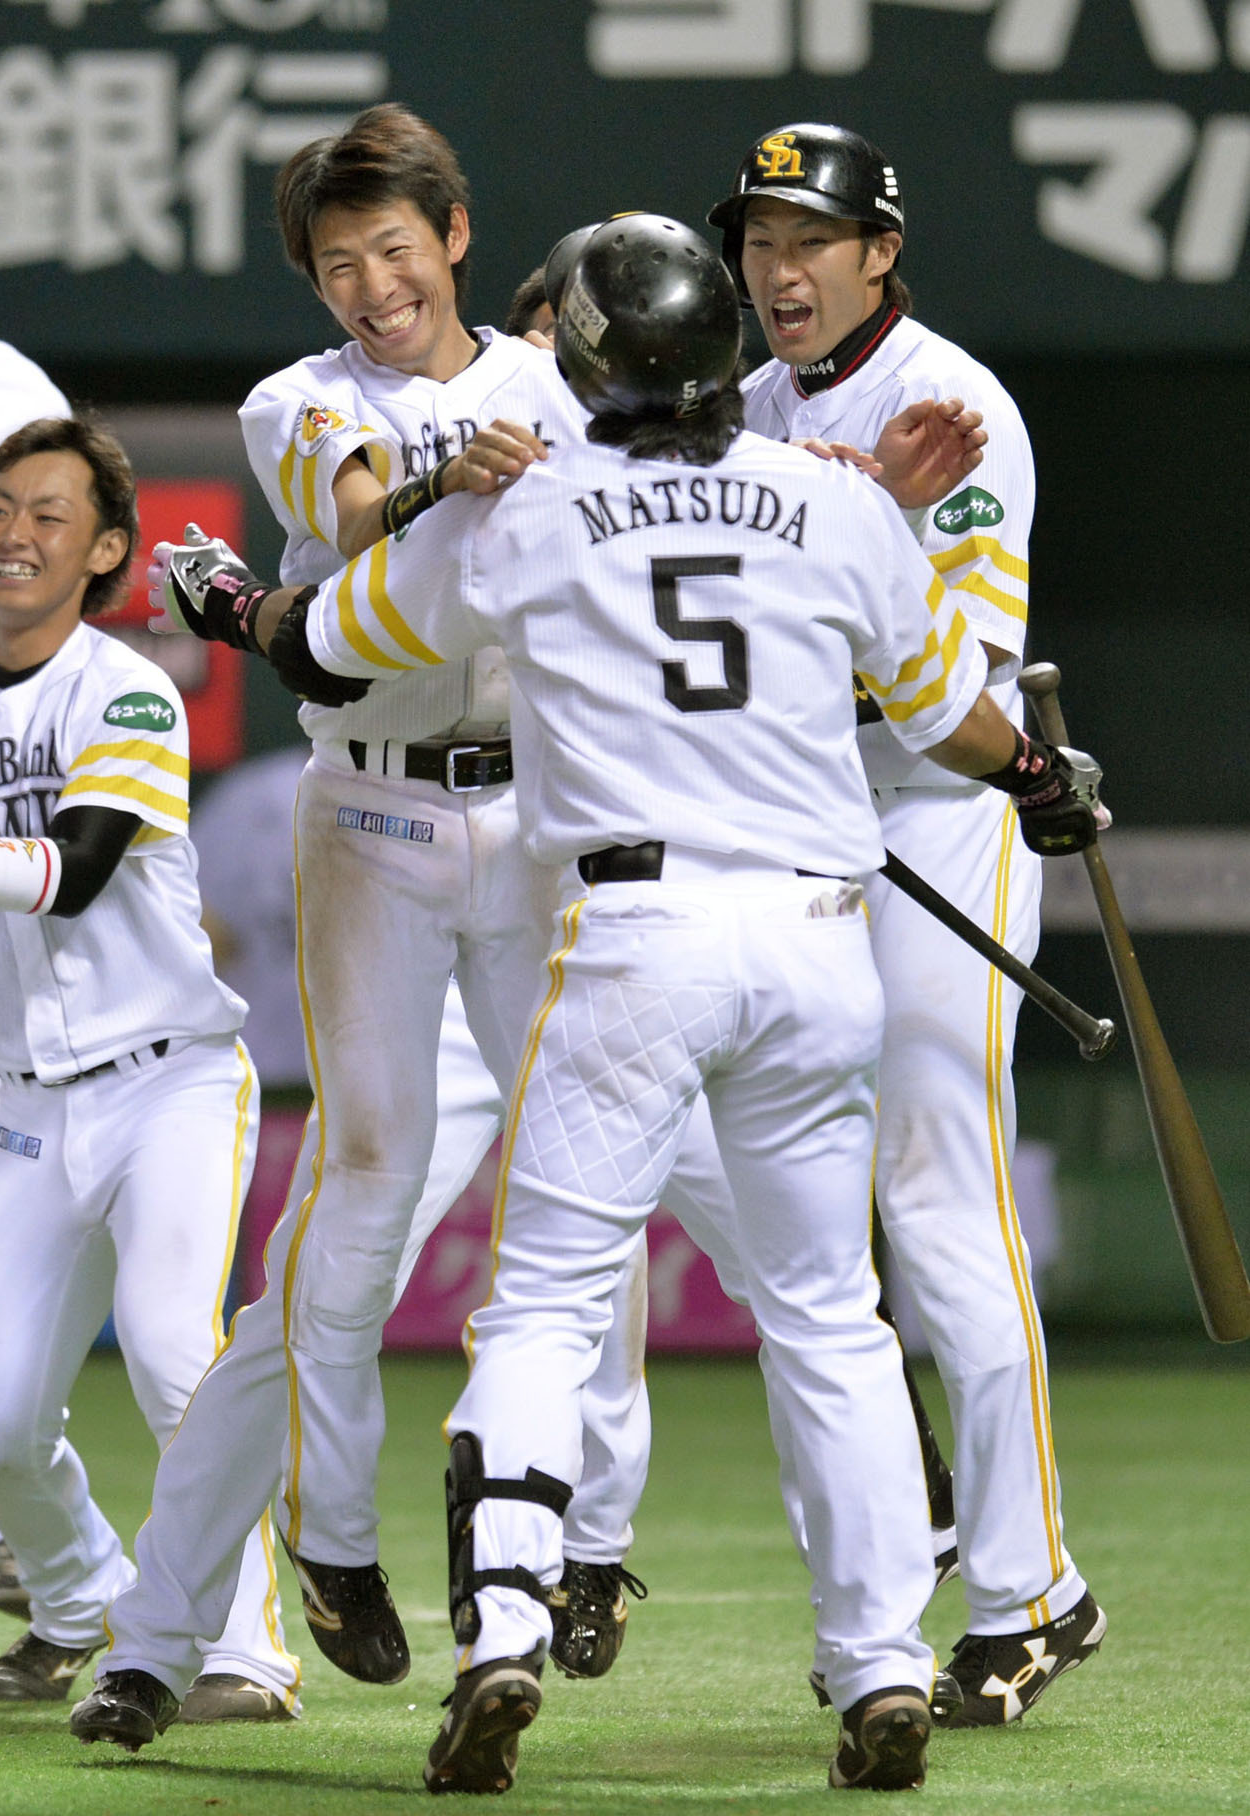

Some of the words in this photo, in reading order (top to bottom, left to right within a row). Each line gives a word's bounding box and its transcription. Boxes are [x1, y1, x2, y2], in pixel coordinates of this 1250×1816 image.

[683, 380, 697, 400] 5
[573, 477, 808, 551] MATSUDA
[939, 499, 997, 526] キューサイ
[649, 554, 750, 716] 5
[108, 703, 173, 725] キューサイ
